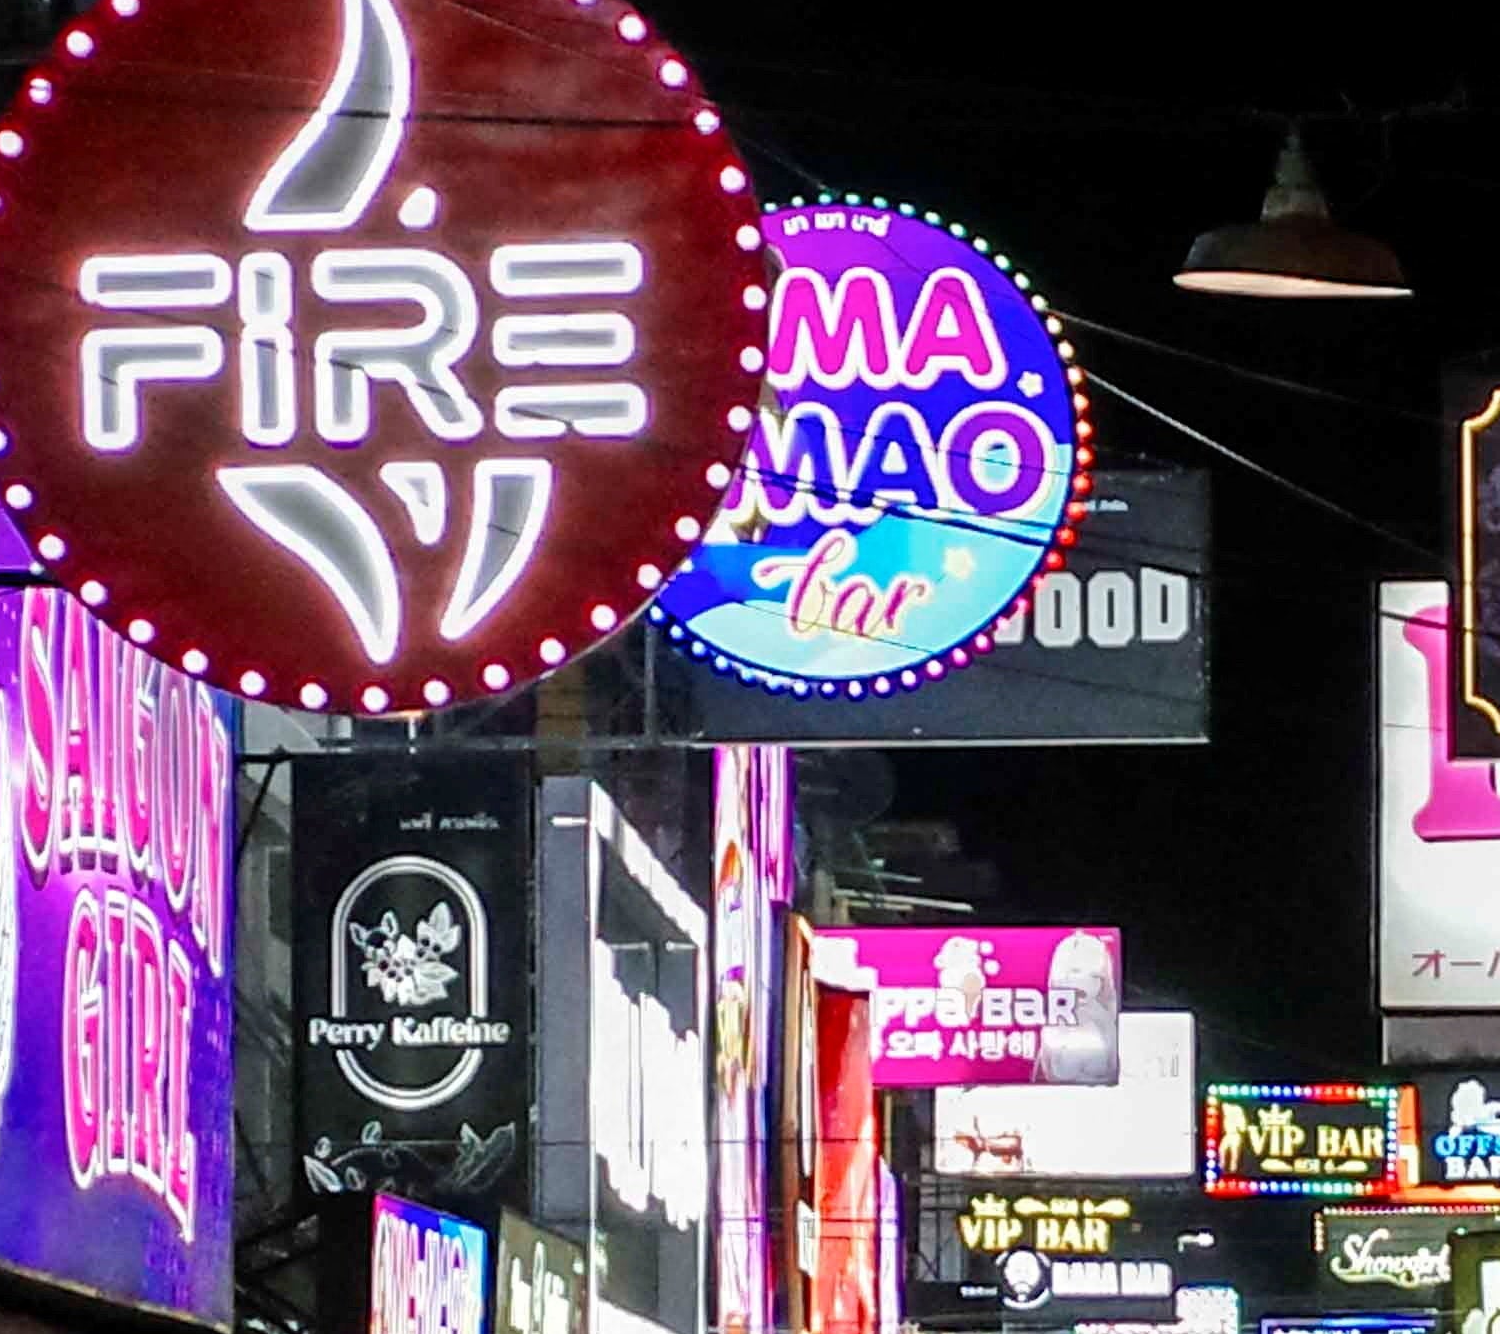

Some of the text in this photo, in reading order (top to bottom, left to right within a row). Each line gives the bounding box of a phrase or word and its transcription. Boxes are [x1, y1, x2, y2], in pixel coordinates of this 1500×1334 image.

[78, 241, 648, 453] FIRE
[767, 266, 1008, 391] MA
[722, 400, 1057, 527] MAO
[751, 528, 932, 639] bar
[994, 567, 1188, 649] OOD
[21, 588, 231, 977] SAIGON
[309, 1014, 510, 1051] Perry Kaffeine
[873, 987, 972, 1028] PPa
[62, 885, 195, 1242] GIRL
[1247, 1124, 1384, 1158] VIP BAR
[960, 1215, 1110, 1253] VIP BAR
